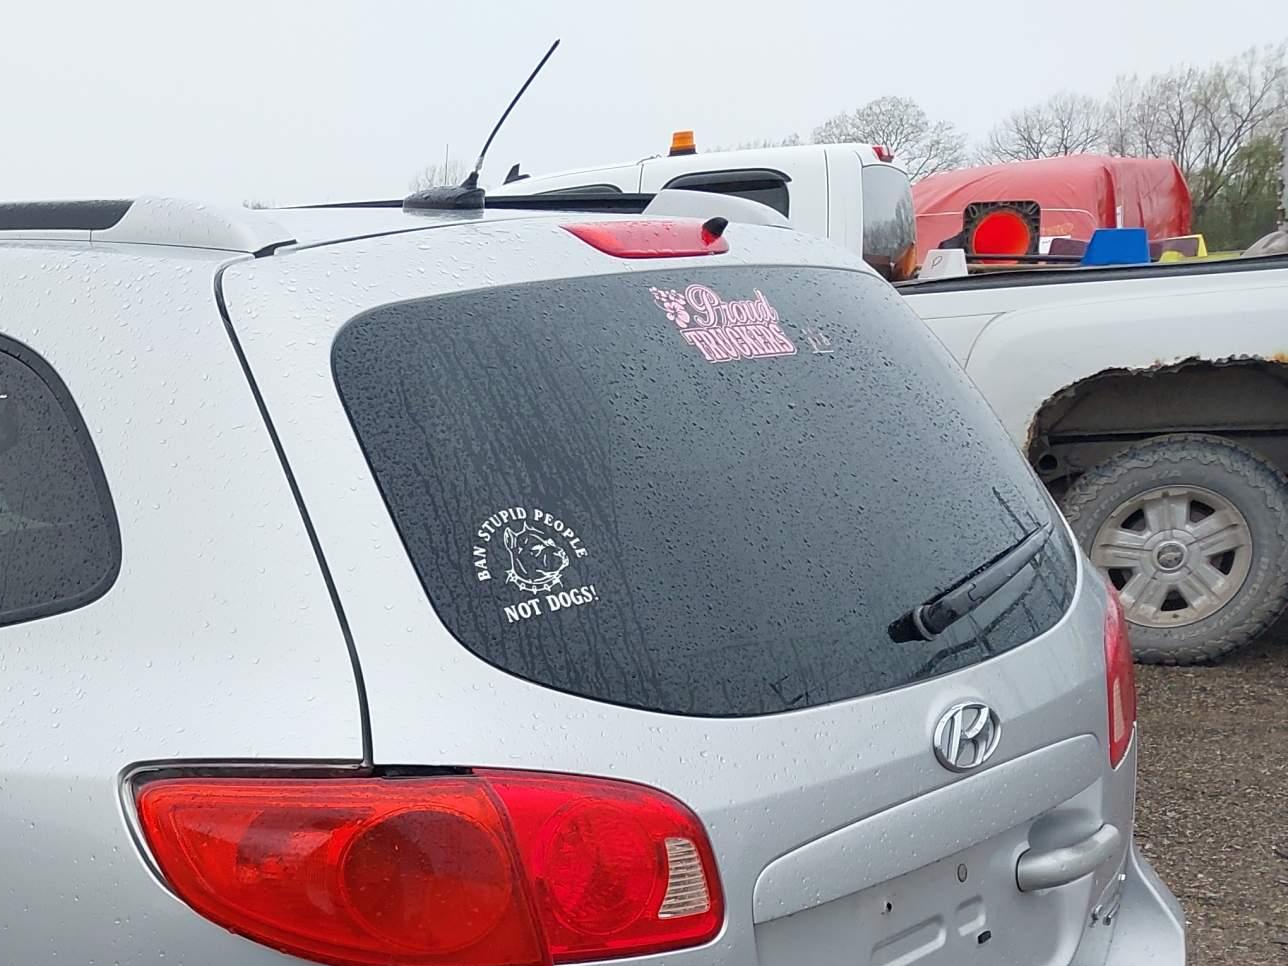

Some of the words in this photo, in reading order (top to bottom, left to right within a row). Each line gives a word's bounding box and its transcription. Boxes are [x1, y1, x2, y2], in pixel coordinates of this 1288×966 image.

[685, 284, 779, 327] Proud
[681, 325, 797, 362] TRUCKERS
[478, 507, 527, 542] STUPID
[534, 509, 588, 558] PEOPLE
[473, 546, 492, 581] BAN
[504, 598, 542, 623] NOT
[546, 584, 600, 612] DOGS!
